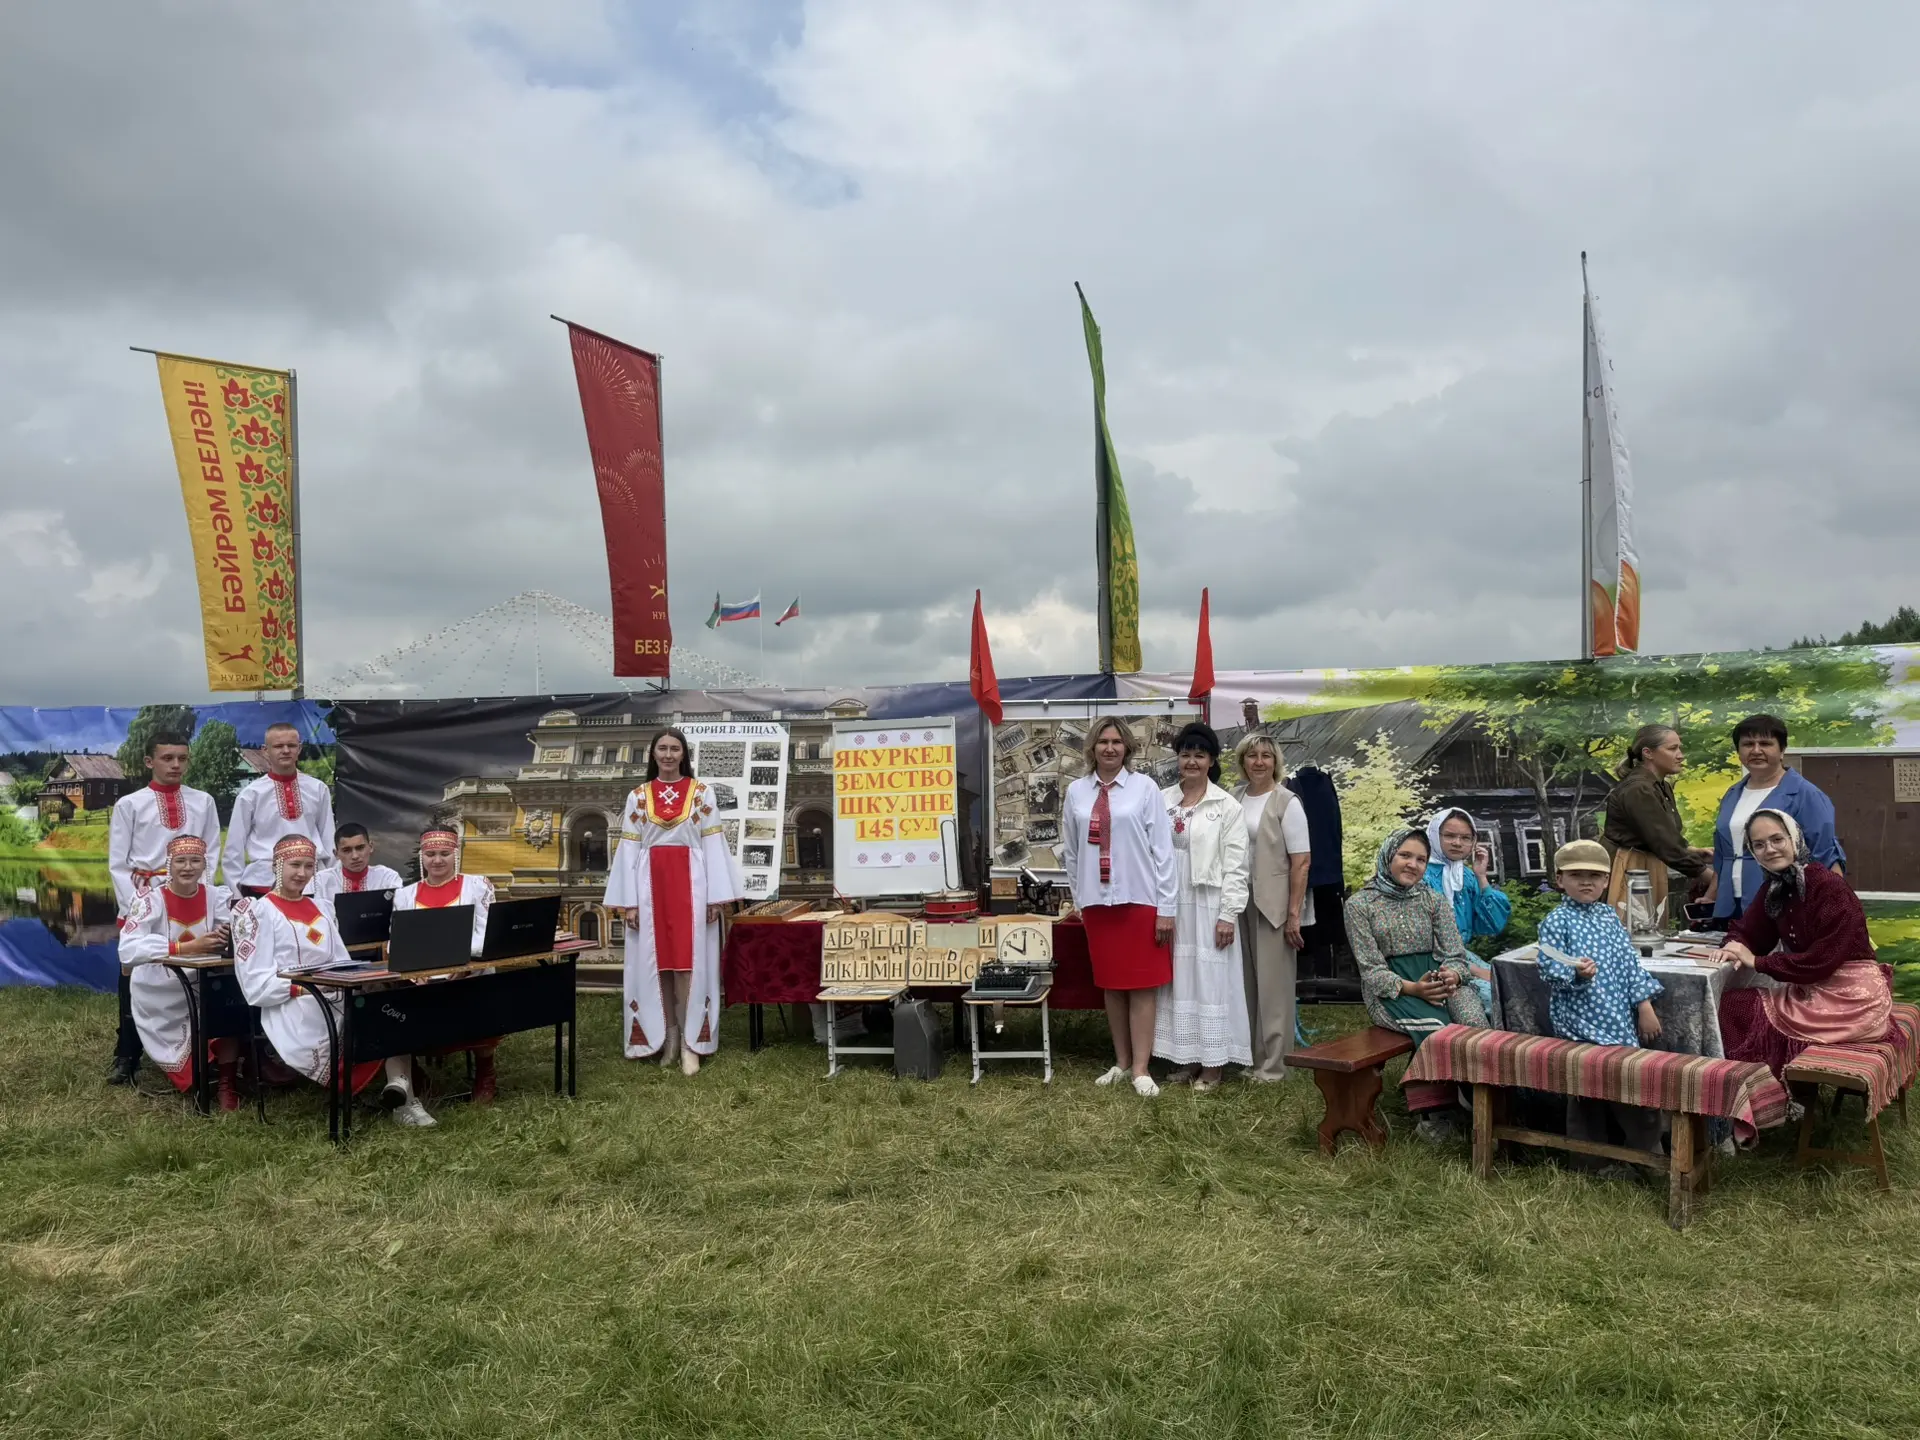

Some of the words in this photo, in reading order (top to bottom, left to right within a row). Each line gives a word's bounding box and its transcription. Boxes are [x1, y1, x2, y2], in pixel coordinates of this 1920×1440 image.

[183, 380, 225, 483] БЕЛӘН!
[206, 488, 246, 613] БӘЙРӘМ
[635, 639, 661, 655] БЕЗ
[220, 674, 259, 682] НУРЛАТ
[729, 725, 736, 734] В
[738, 725, 778, 735] ЛИЦАХ
[835, 745, 953, 768] ЯКУРКЕЛ
[836, 769, 954, 791] ЗЕМСТВО
[840, 794, 953, 815] ШКУЛНЕ
[858, 819, 894, 838] 145
[826, 932, 836, 946] А
[843, 930, 853, 945] Б
[878, 930, 887, 944] Г
[982, 929, 992, 943] И
[842, 963, 852, 978] К
[858, 963, 868, 978] Л
[874, 963, 887, 978] М
[892, 963, 902, 978] Н
[929, 963, 940, 978] П
[947, 963, 957, 978] Р
